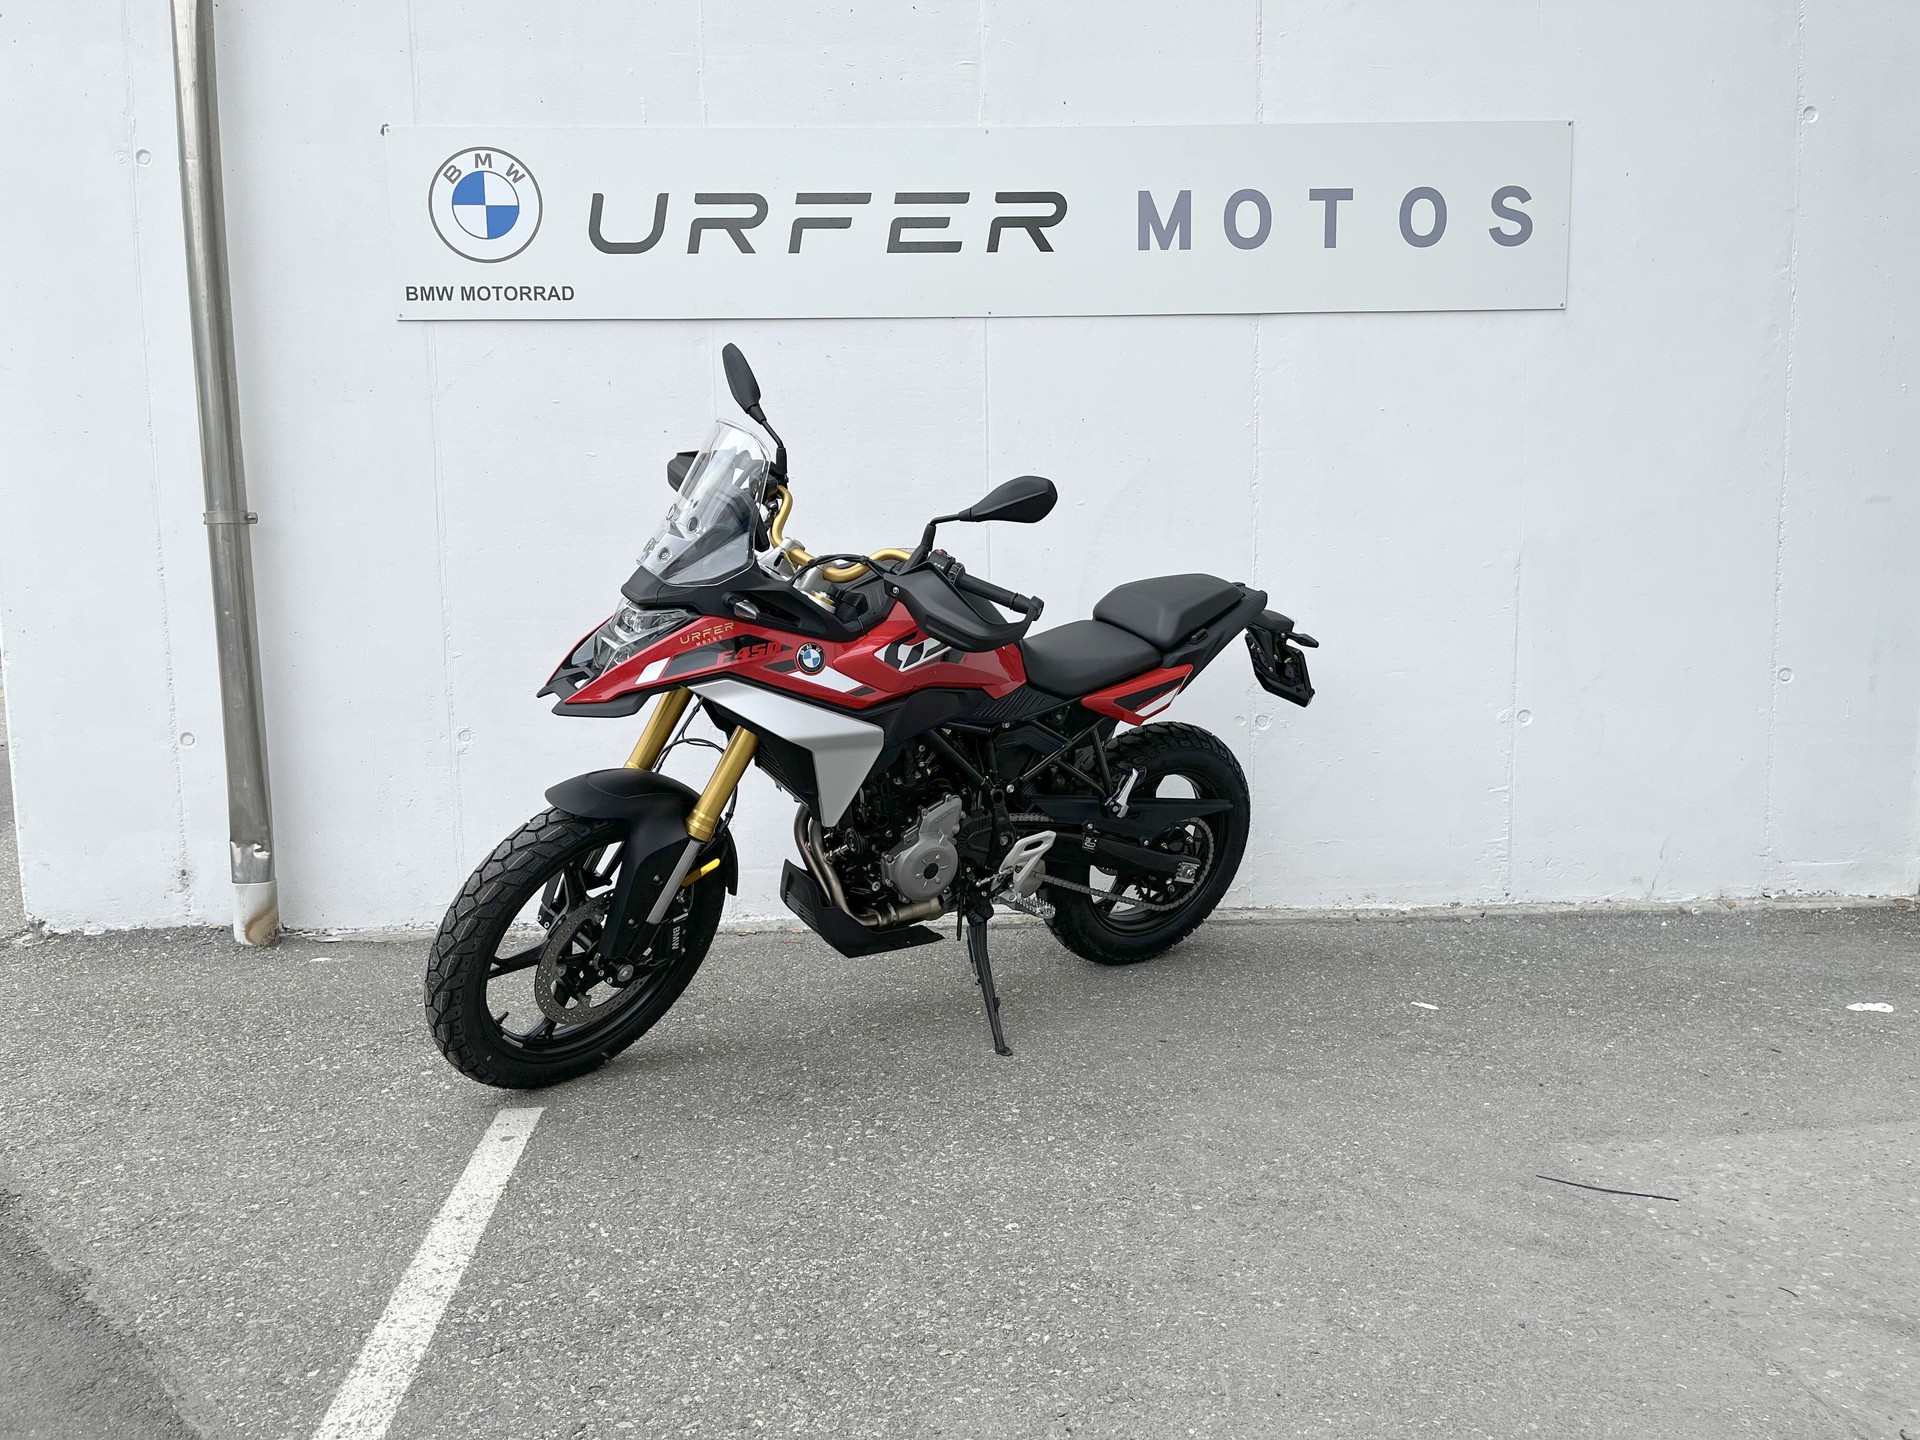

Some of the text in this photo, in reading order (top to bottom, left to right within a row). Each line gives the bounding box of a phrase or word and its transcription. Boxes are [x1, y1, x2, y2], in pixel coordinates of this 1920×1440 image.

[443, 153, 526, 185] BMW
[588, 185, 1534, 254] URFER MOTOS
[405, 286, 575, 301] BMW MOTORRAD
[680, 622, 734, 644] URFER
[696, 635, 723, 646] MOTOS
[671, 926, 681, 950] BMW
